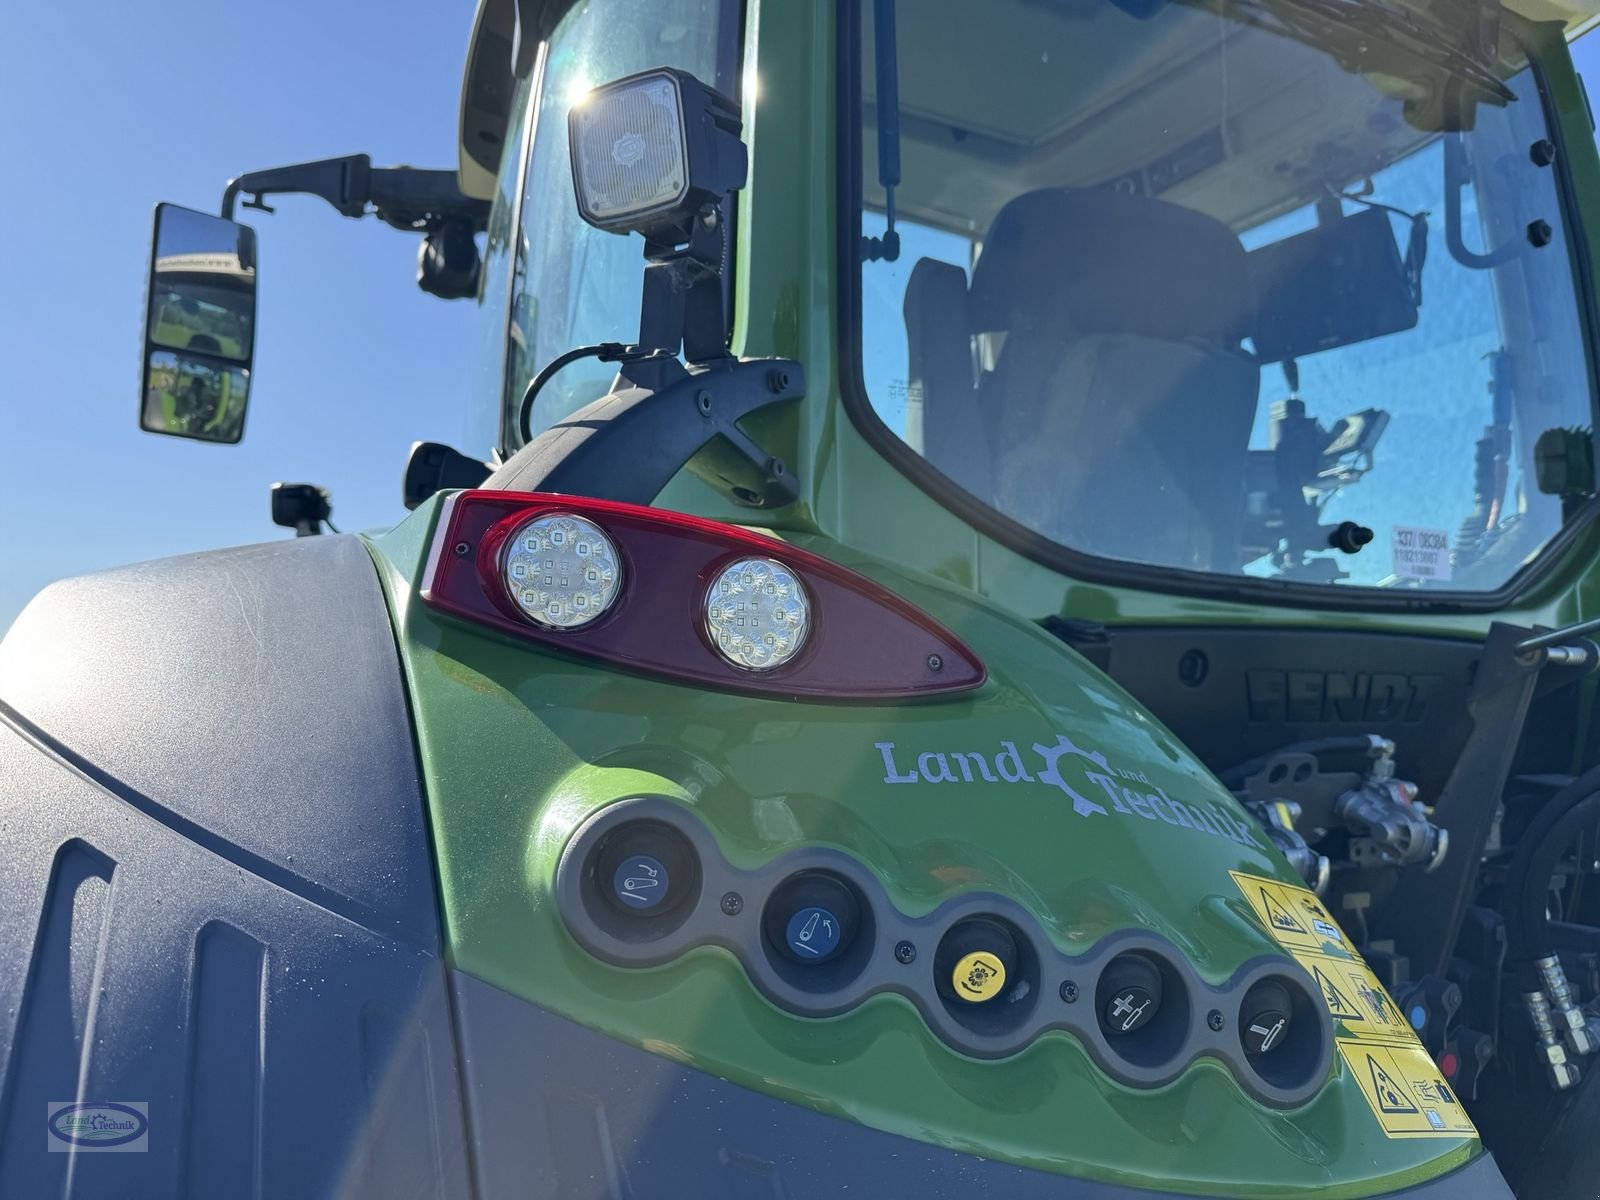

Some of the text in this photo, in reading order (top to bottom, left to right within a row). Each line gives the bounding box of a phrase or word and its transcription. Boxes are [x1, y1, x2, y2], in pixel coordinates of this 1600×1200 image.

[1245, 669, 1445, 725] FENDT
[874, 741, 1266, 851] Land und Technik
